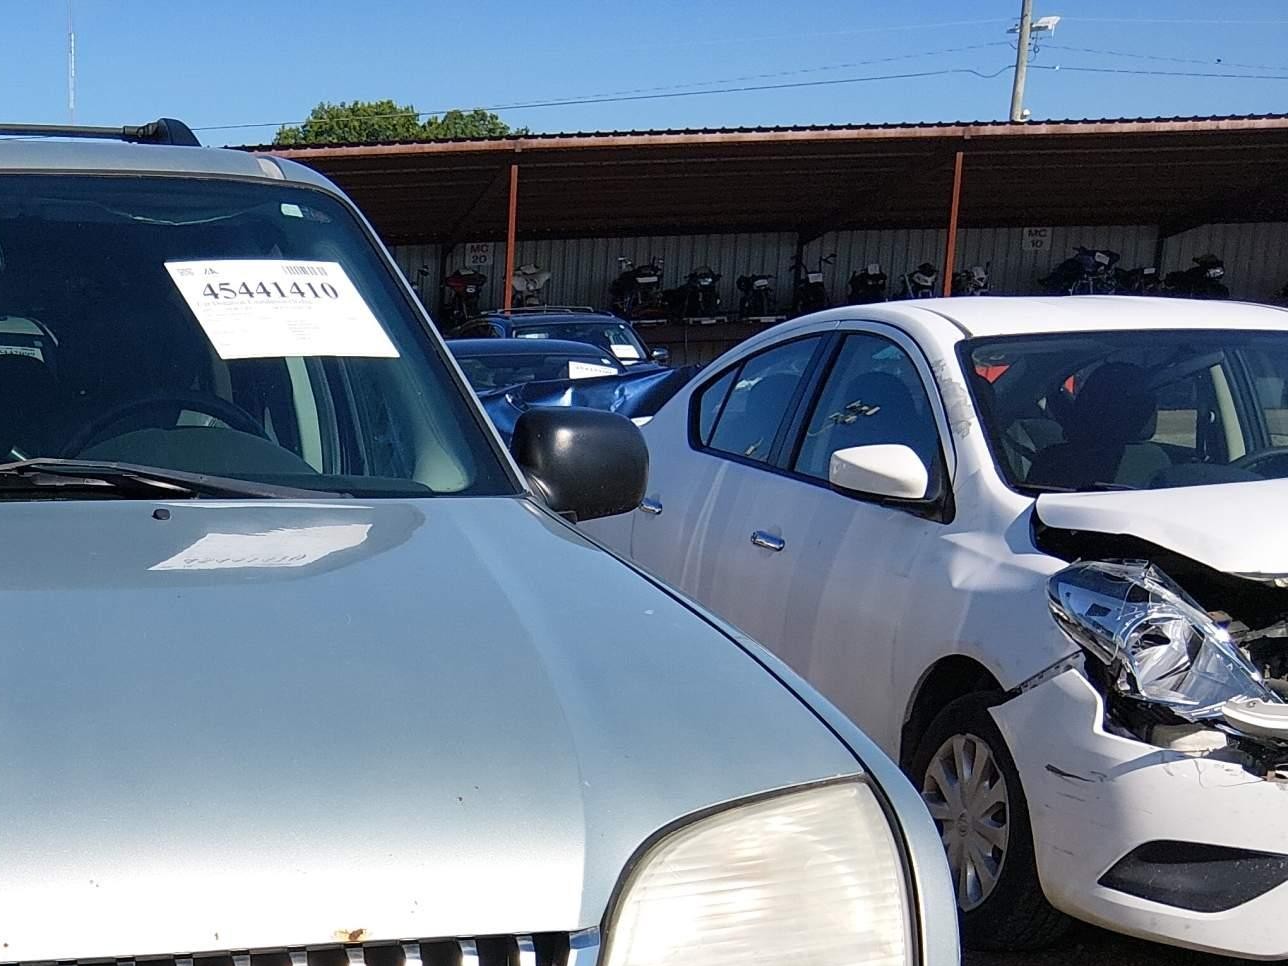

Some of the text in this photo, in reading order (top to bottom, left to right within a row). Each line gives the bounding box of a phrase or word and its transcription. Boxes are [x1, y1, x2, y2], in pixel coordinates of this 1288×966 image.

[470, 244, 489, 253] MC
[472, 255, 487, 264] 20
[202, 281, 339, 300] 45441410
